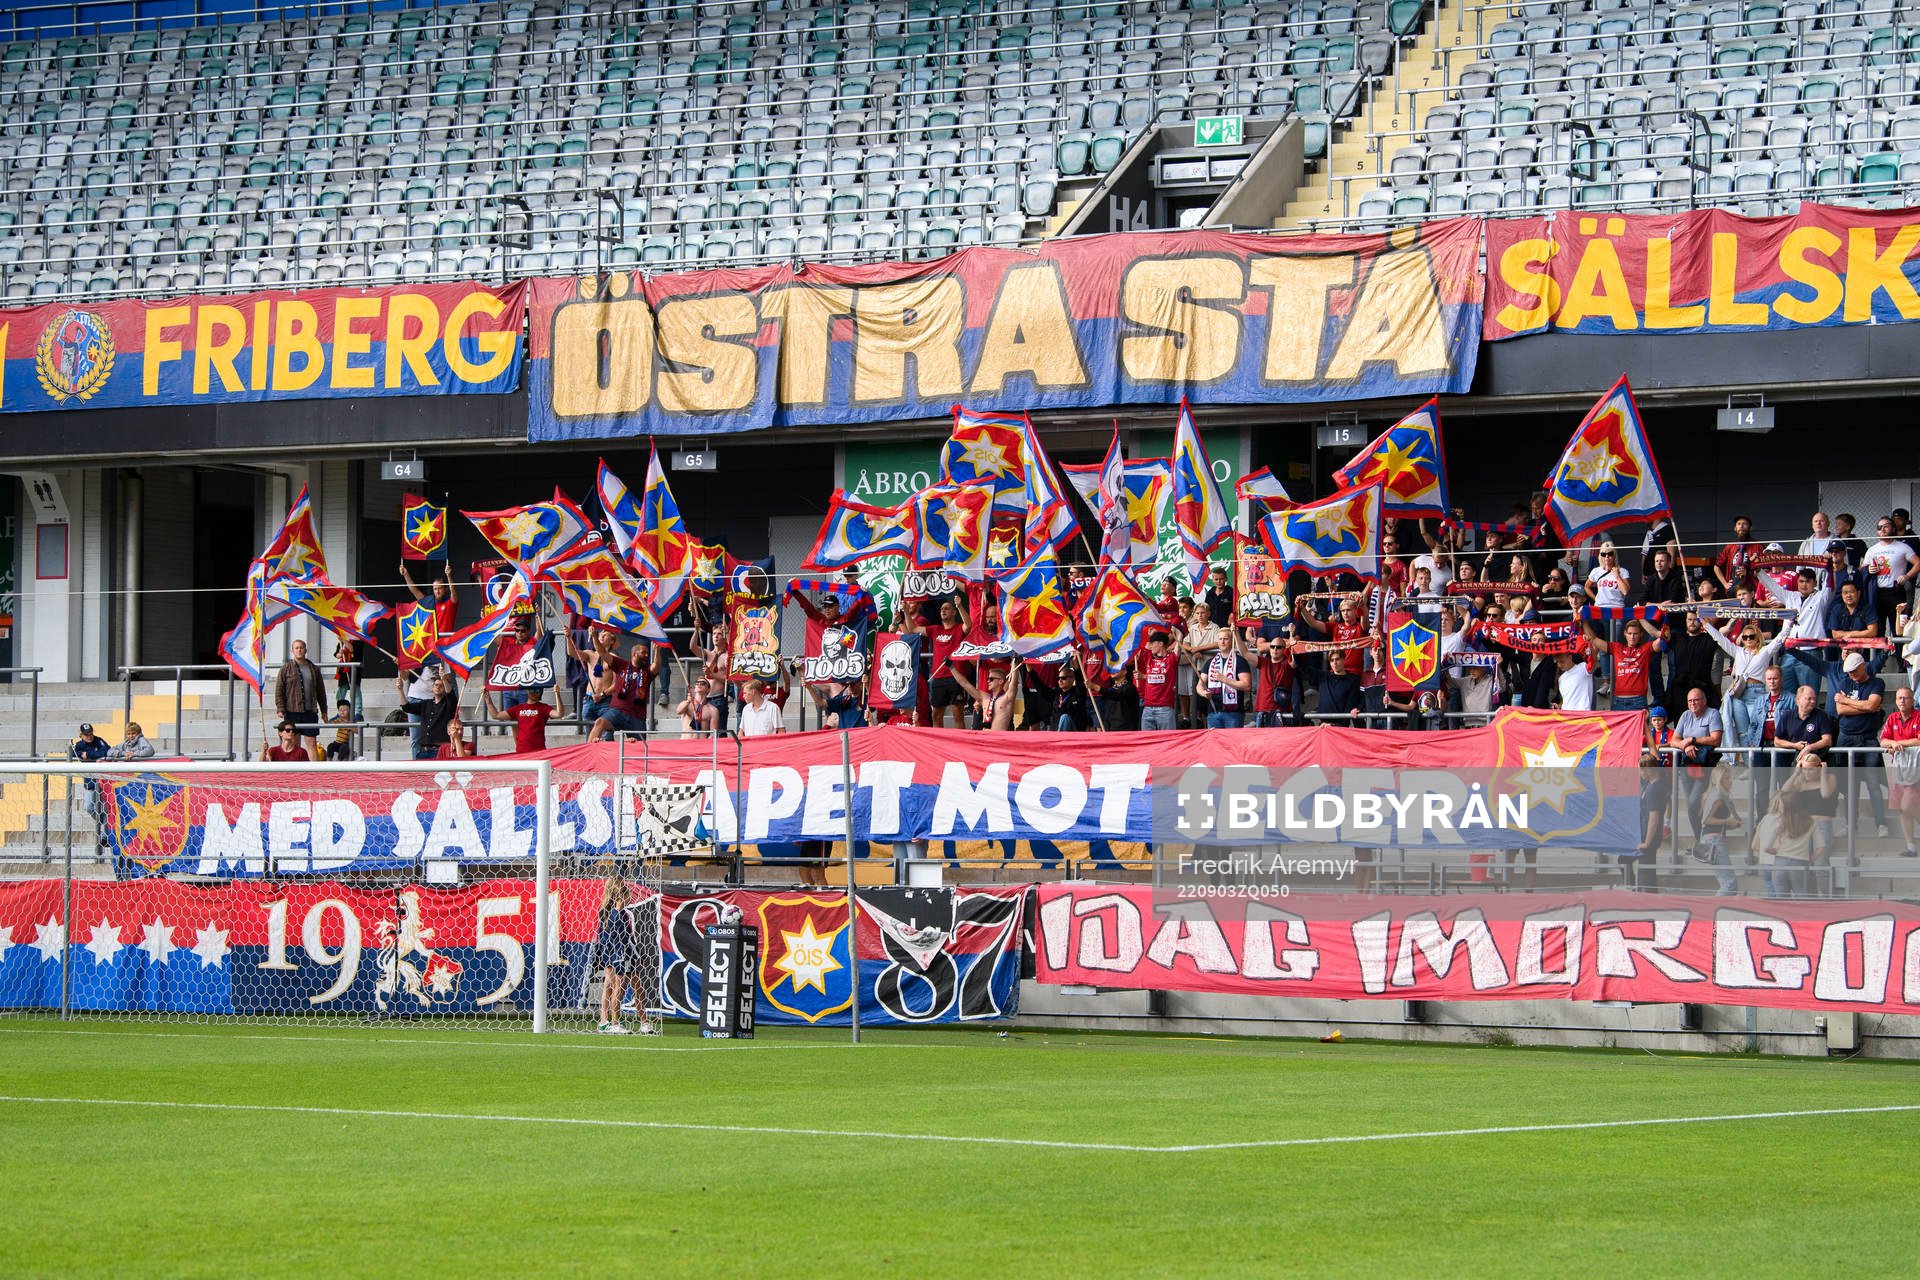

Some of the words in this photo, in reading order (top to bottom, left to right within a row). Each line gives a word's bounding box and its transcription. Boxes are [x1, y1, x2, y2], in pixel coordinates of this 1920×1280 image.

[1423, 77, 1430, 86] 7
[1391, 119, 1399, 128] 6
[1356, 161, 1364, 170] 5
[1109, 194, 1150, 232] H4
[1323, 203, 1331, 214] 4
[1495, 217, 1920, 332] SÄLLSK
[550, 256, 1092, 421] ÖSTRA
[1118, 225, 1458, 389] STÅ
[142, 292, 518, 397] FRIBERG
[394, 464, 412, 476] G4
[685, 454, 703, 467] G5
[853, 468, 931, 496] ÅBRO
[1237, 591, 1290, 618] ACAB
[1529, 760, 1567, 787] ÖIS
[196, 798, 367, 876] MED
[930, 761, 1150, 835] MOT
[1174, 763, 1467, 845] SEGER
[257, 897, 362, 1005] 19
[792, 942, 823, 967] ÖIS
[706, 939, 730, 1028] SELECT
[739, 941, 756, 1030] SELECT
